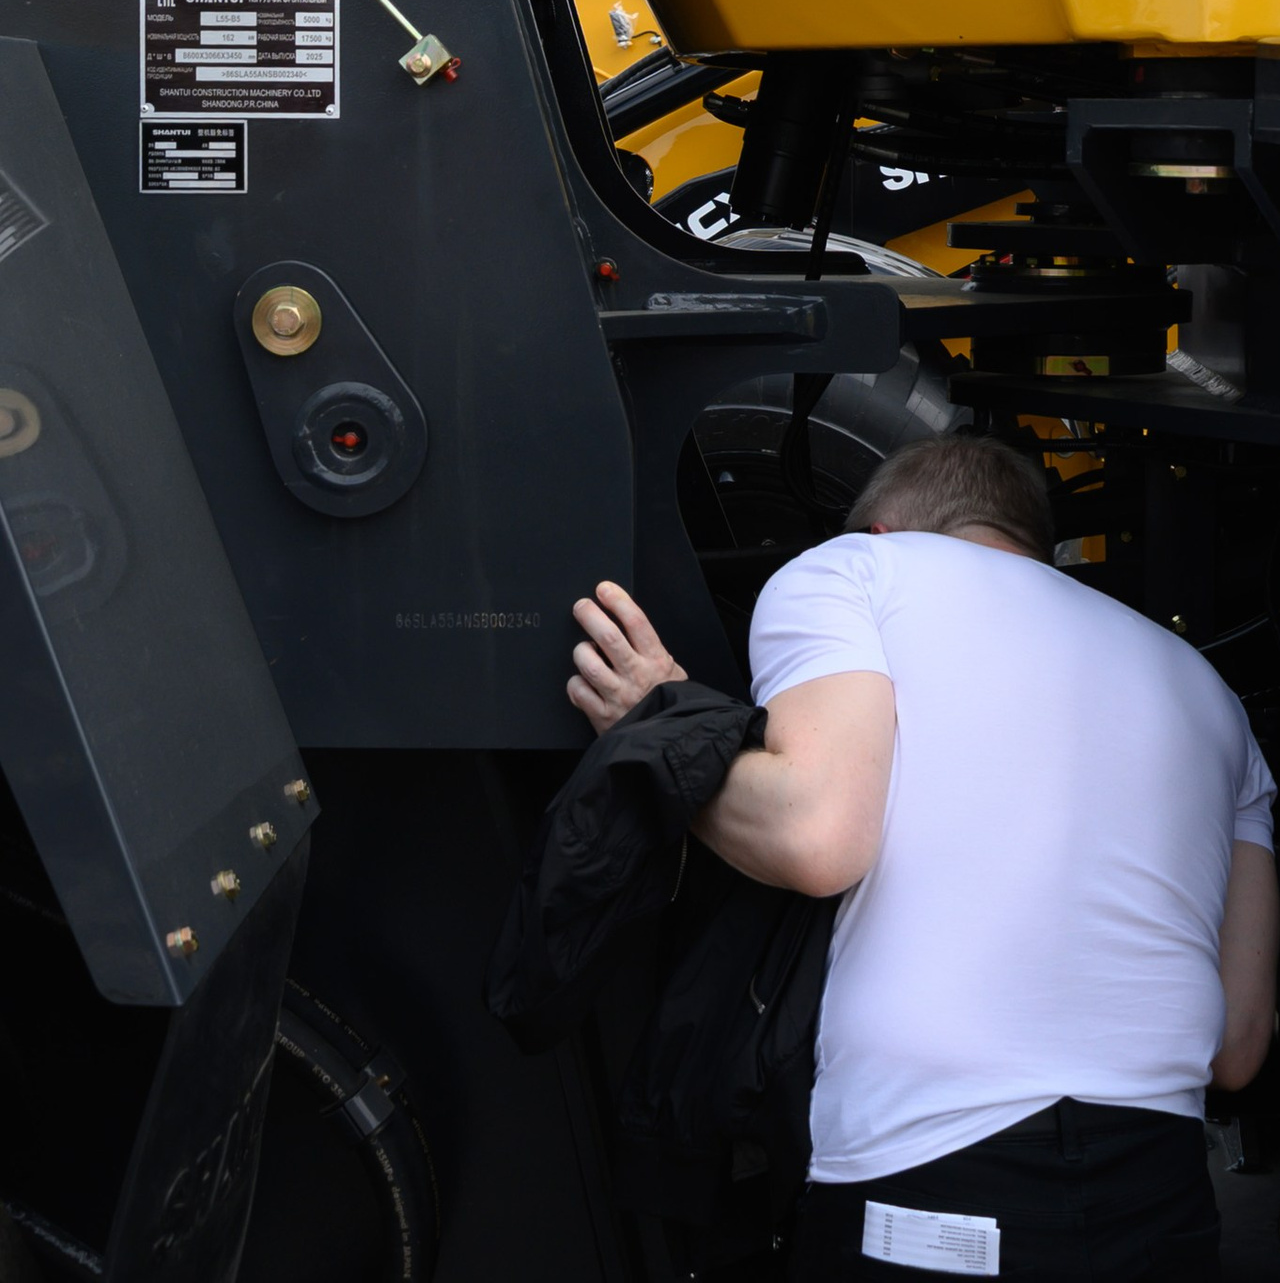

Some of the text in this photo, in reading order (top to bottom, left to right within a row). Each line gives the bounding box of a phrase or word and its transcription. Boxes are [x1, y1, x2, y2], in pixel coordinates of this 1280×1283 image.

[146, 14, 174, 22] МОДЕЛЬ
[303, 16, 321, 24] 5000
[221, 34, 235, 42] 162
[301, 35, 323, 43] 17500
[257, 52, 296, 61] ДАТА ВЫПУСКА
[305, 52, 324, 61] 2025
[159, 88, 191, 97] SHANTUI
[192, 88, 249, 97] CONSTRUCTION
[250, 88, 292, 97] MACHINERY
